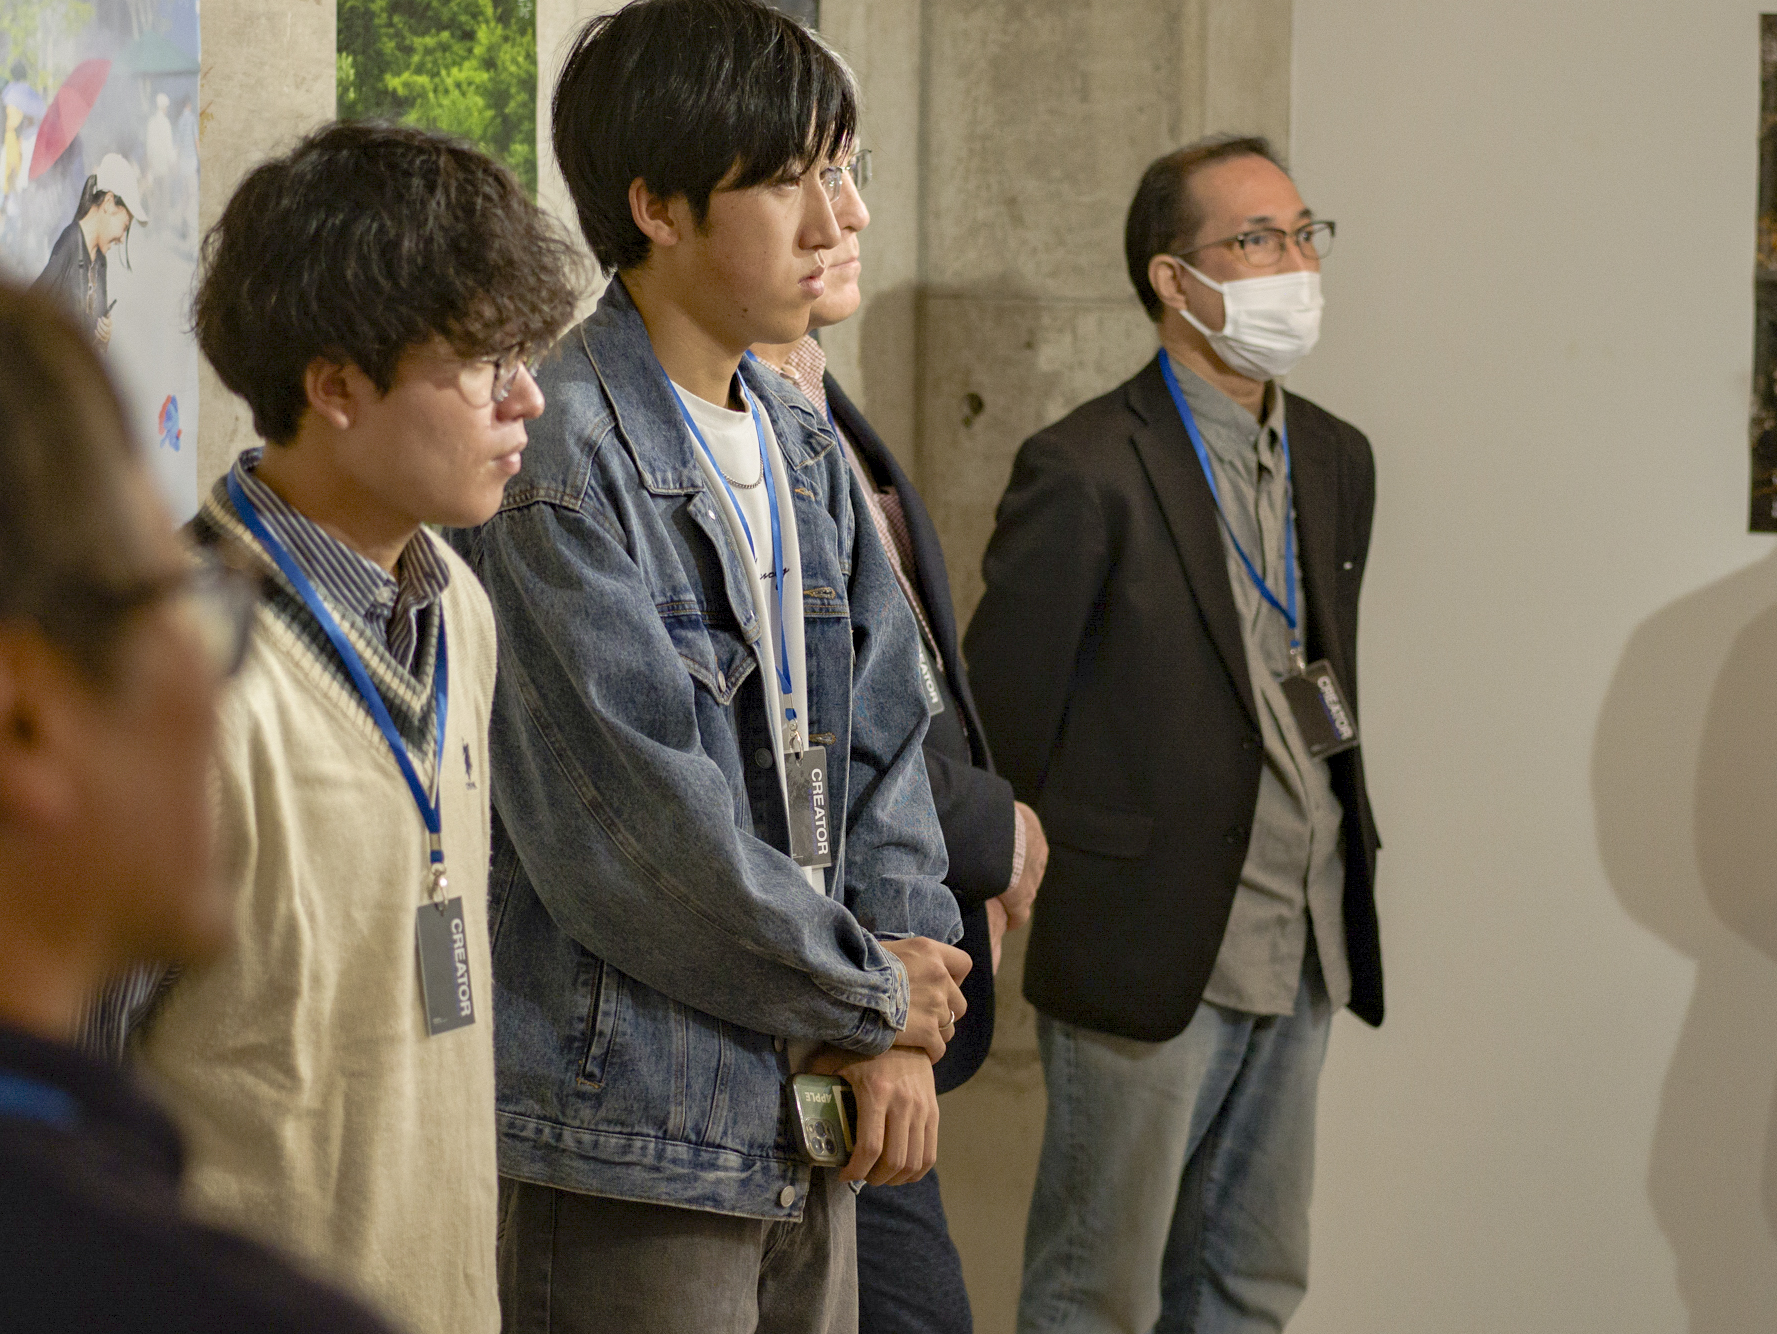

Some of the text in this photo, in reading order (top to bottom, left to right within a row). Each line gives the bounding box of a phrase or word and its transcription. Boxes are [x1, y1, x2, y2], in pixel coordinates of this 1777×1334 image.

[1316, 675, 1353, 740] CREATOR
[810, 768, 829, 855] CREATOR
[451, 918, 472, 1017] CREATOR
[804, 1091, 832, 1103] APPLE
